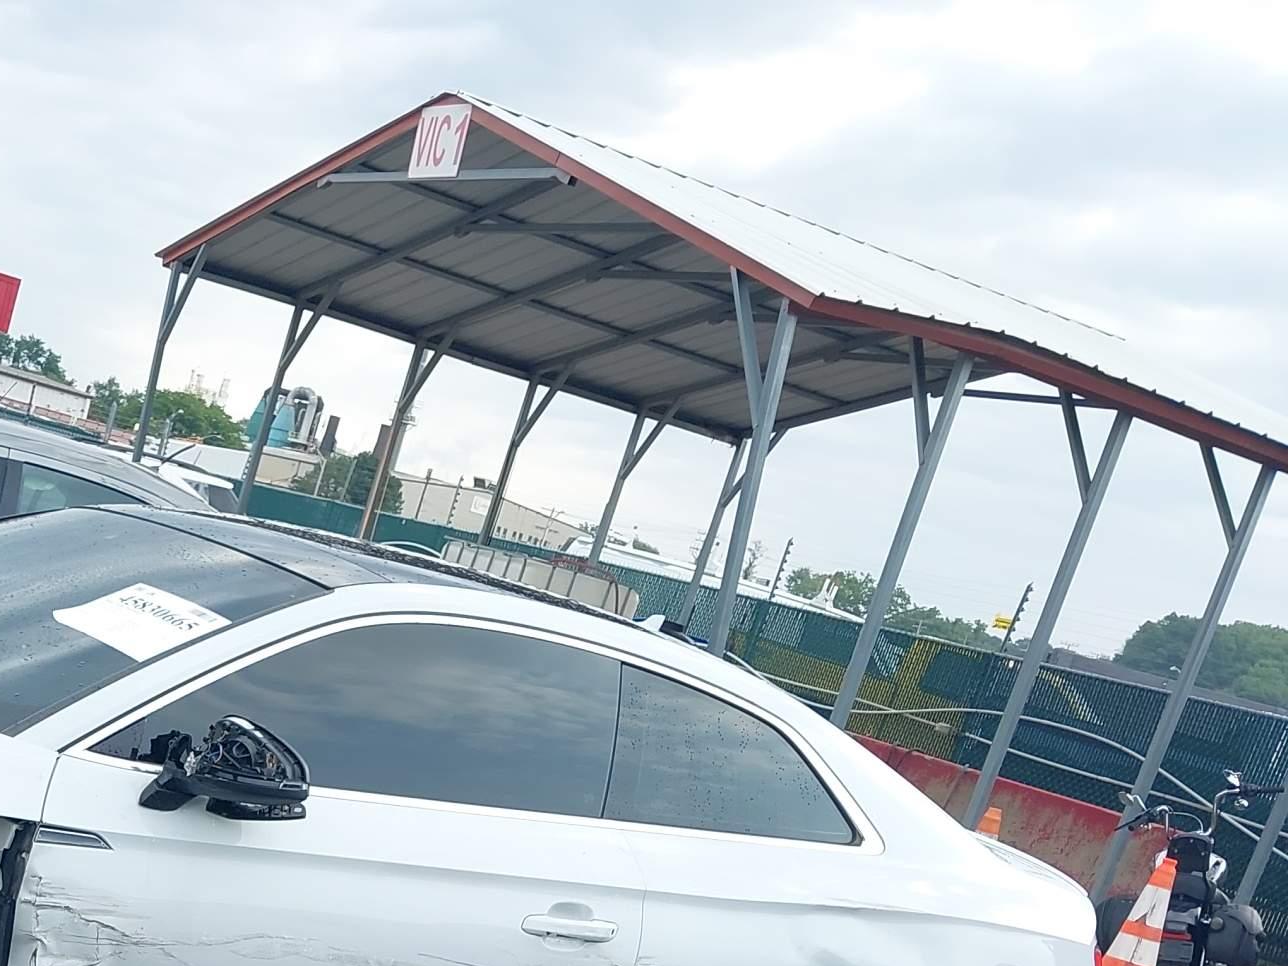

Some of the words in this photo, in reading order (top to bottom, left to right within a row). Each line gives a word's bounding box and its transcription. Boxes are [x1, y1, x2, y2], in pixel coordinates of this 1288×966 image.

[416, 114, 451, 167] VIC
[453, 113, 468, 165] 1
[120, 595, 200, 630] 45830665
